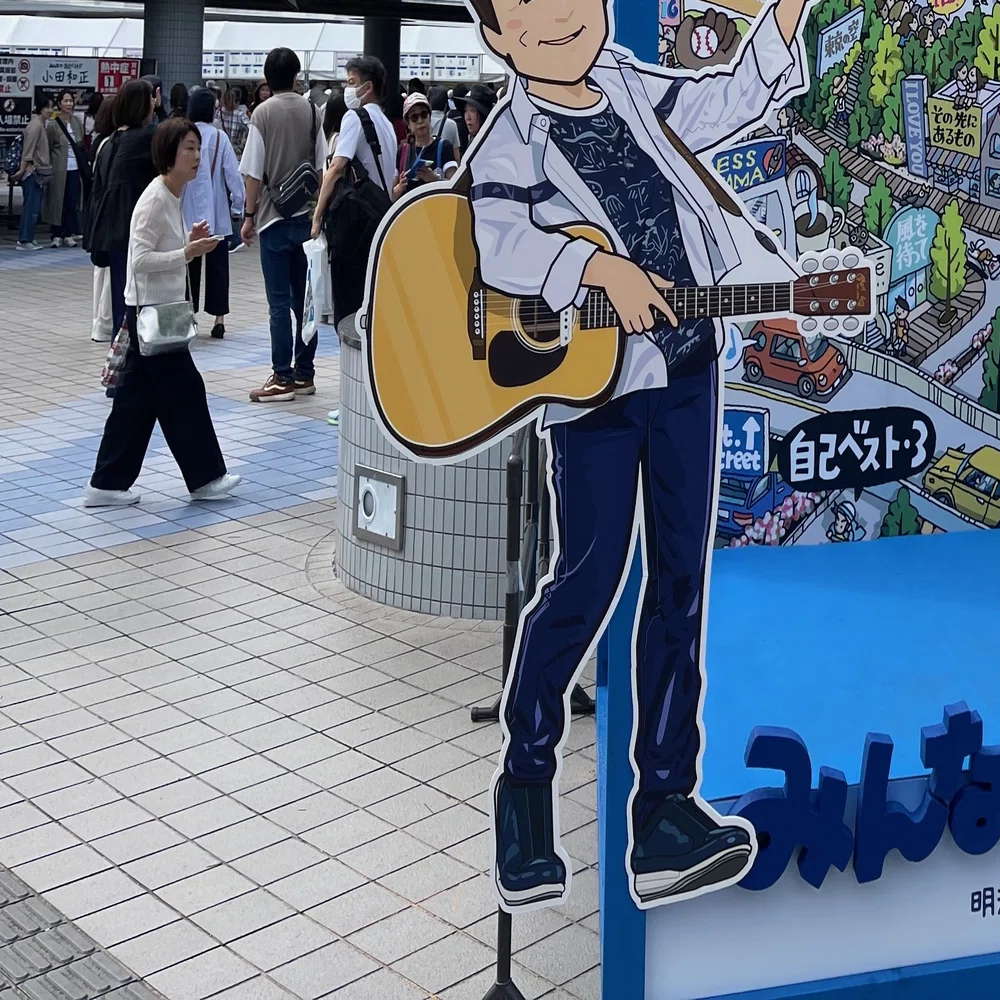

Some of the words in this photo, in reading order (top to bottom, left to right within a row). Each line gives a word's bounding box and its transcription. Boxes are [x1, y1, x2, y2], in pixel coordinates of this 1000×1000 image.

[825, 19, 859, 58] 東京の空
[42, 70, 89, 84] 小田和正
[906, 92, 920, 138] LOVE
[931, 105, 977, 128] その先に
[933, 125, 975, 148] あるもの
[910, 141, 923, 176] YOU
[896, 214, 927, 245] 風を
[896, 237, 928, 270] 待って
